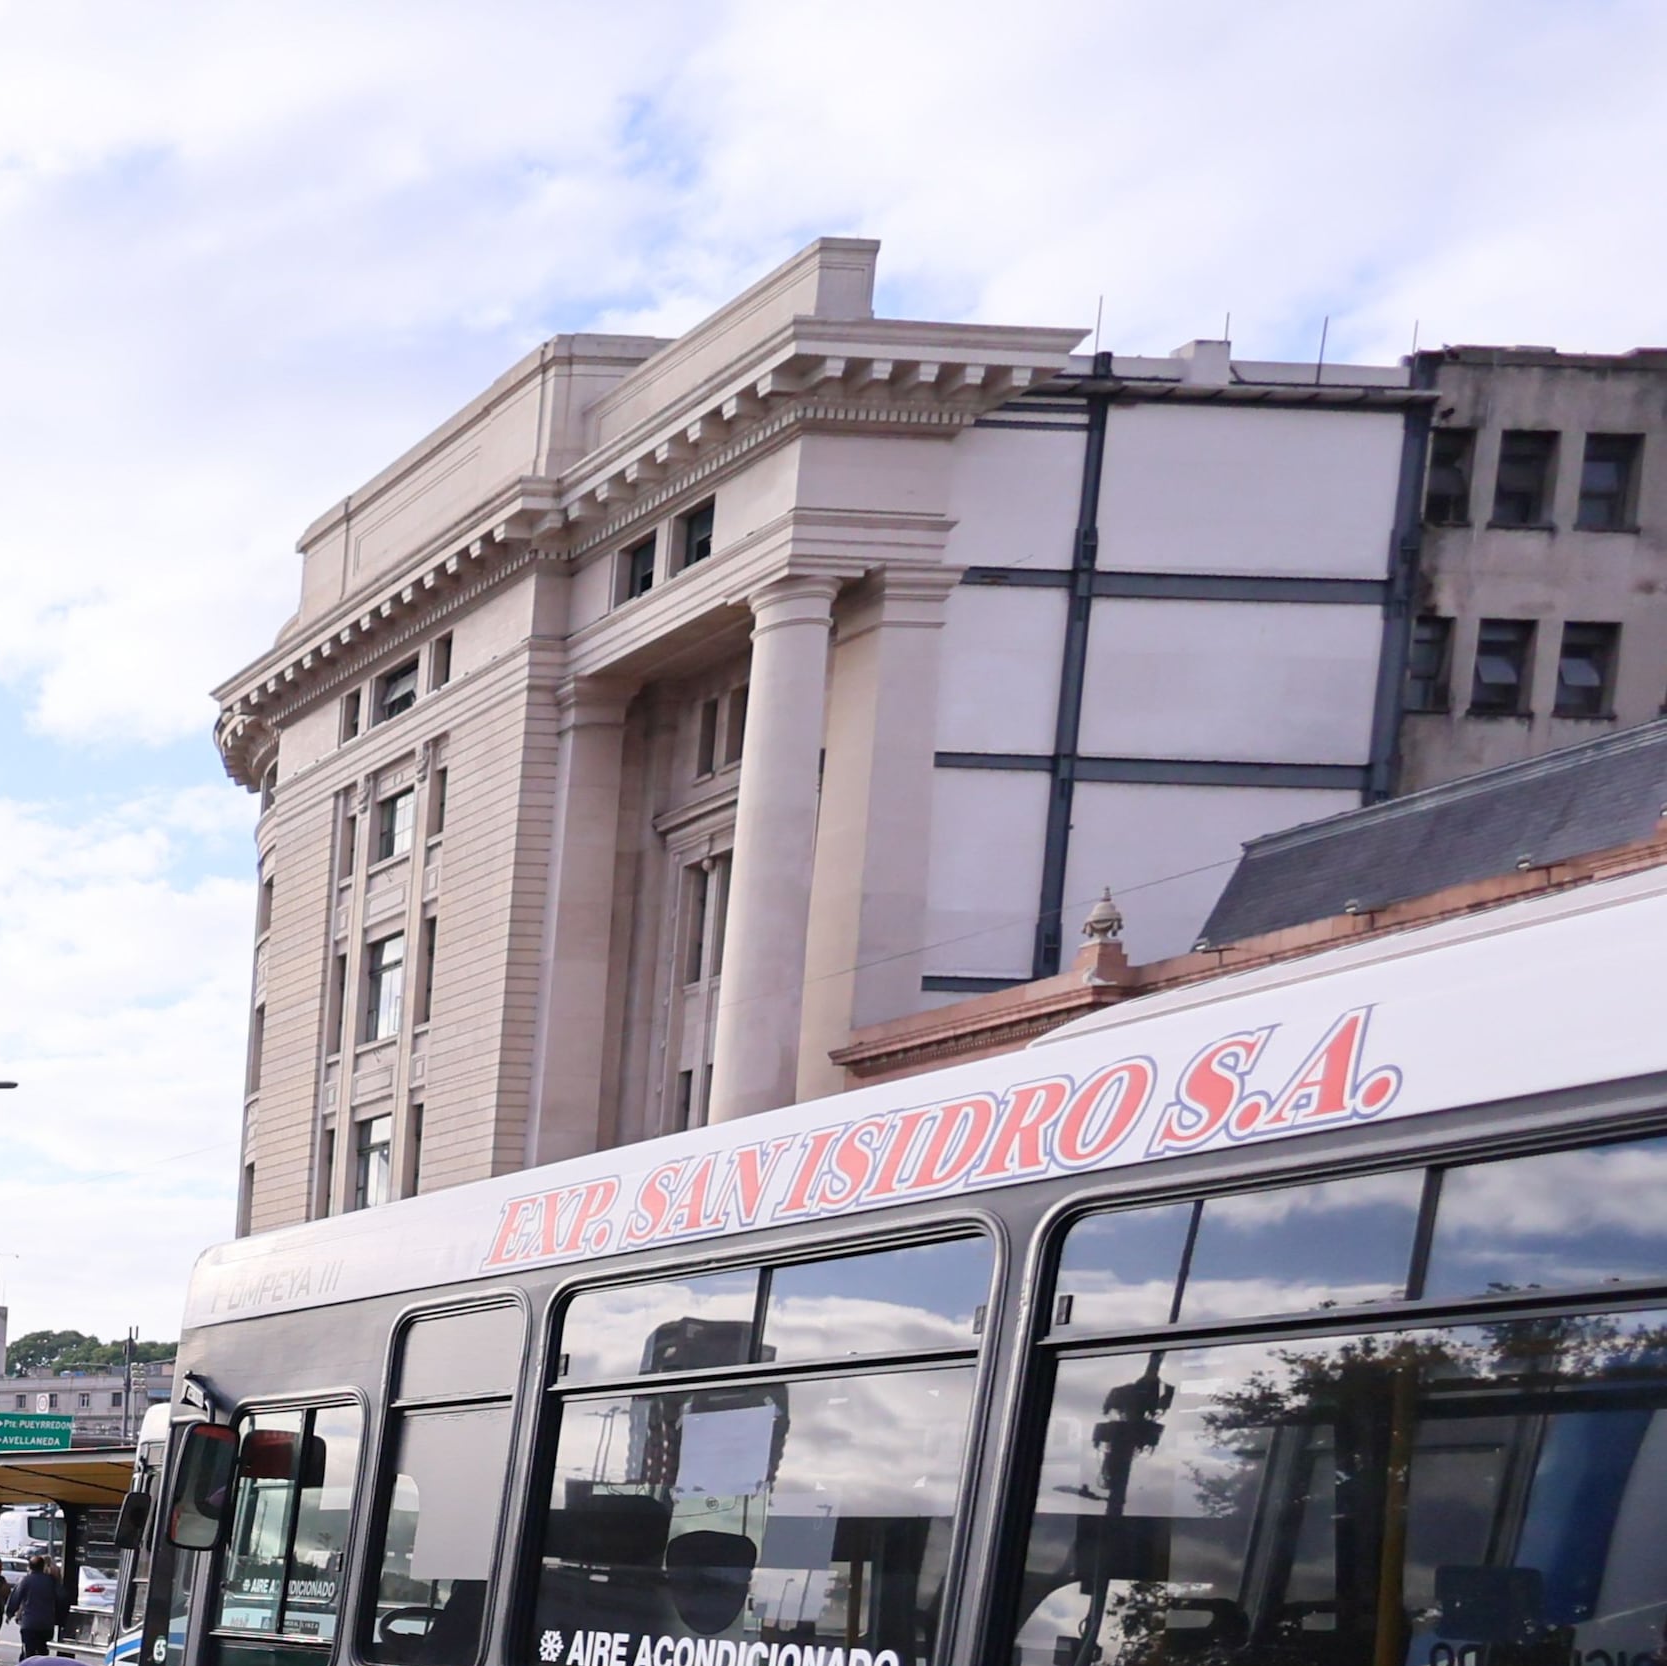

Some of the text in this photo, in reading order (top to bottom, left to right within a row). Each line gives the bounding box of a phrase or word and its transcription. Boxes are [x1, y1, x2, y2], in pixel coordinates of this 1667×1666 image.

[484, 1004, 1403, 1275] EXP. SAN ISIDRO S.A.
[210, 1264, 312, 1315] POMPEYA
[19, 1420, 72, 1430] PUEYRREDON
[1, 1436, 61, 1446] AVELLANEDA
[250, 1579, 270, 1593] AIRE
